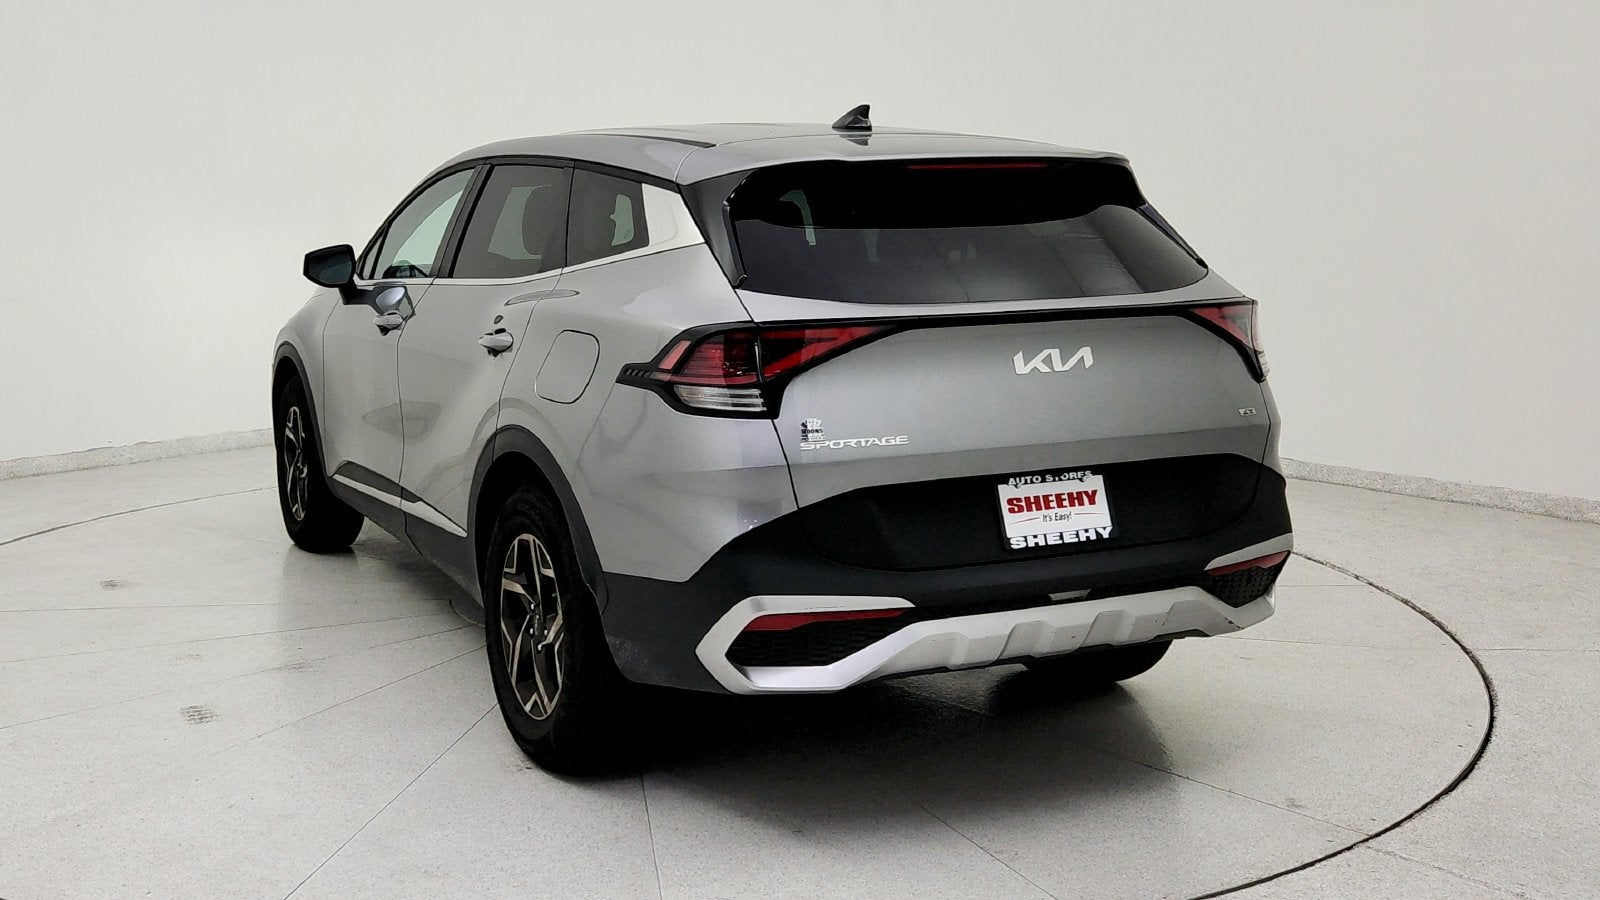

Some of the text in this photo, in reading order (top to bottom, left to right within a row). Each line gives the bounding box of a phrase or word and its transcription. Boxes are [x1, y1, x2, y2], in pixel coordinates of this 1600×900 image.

[1013, 346, 1094, 374] KIA
[800, 435, 910, 450] SPORTAGE
[1008, 475, 1041, 487] AUTO
[1006, 489, 1098, 514] SHEEHY
[1042, 511, 1073, 523] It's Easy!
[1009, 526, 1113, 549] SHEEHY
